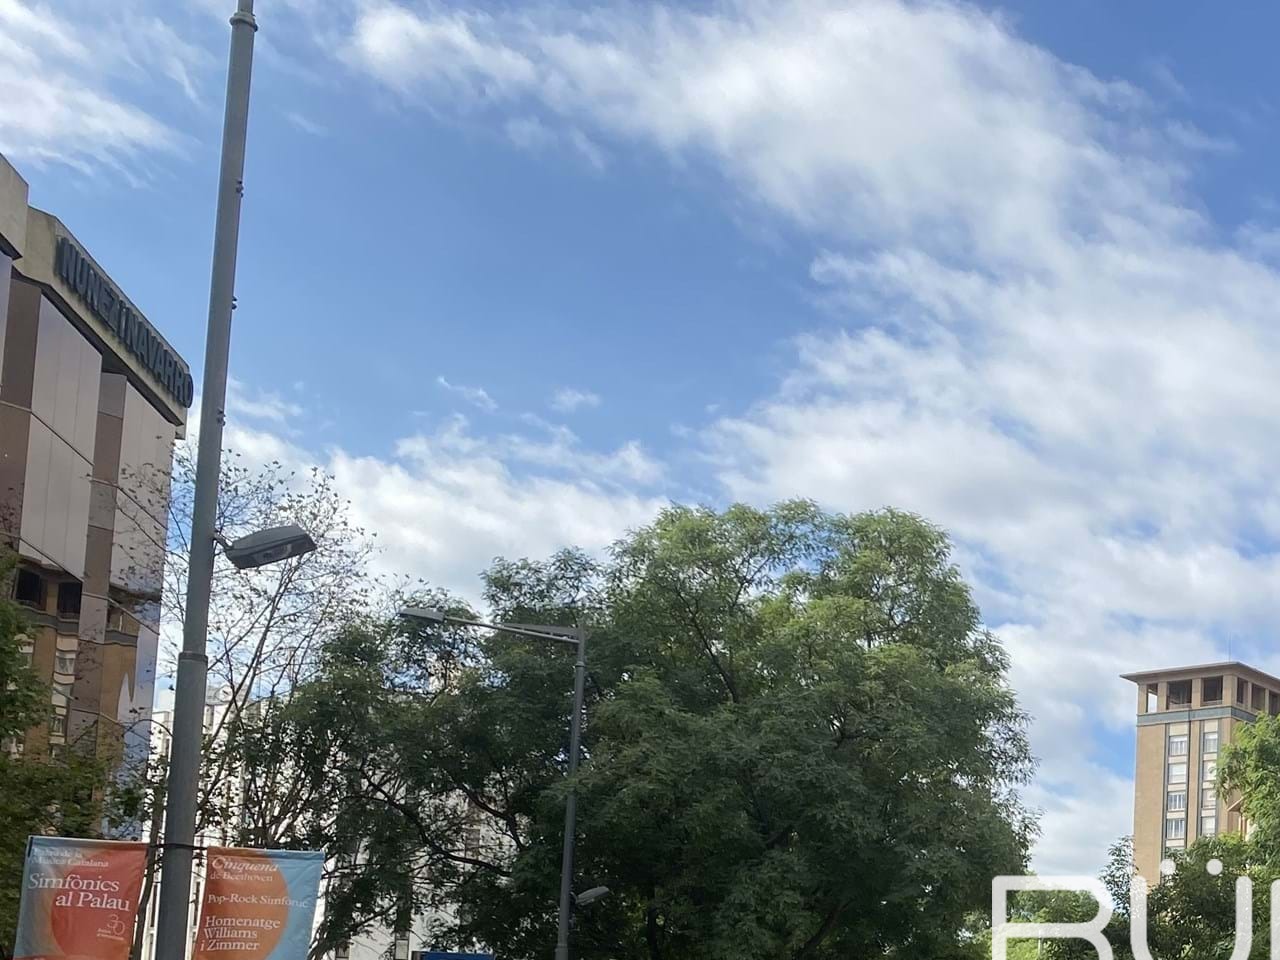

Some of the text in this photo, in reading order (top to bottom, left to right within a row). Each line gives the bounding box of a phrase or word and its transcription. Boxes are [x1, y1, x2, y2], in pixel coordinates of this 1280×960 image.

[211, 856, 279, 872] Cinquena
[28, 873, 120, 892] Simfònics
[222, 871, 274, 882] Beethoven
[55, 891, 130, 911] al Palau
[207, 893, 258, 906] Pop-Rock
[205, 915, 281, 930] Homenatge
[203, 926, 258, 939] Williams
[206, 940, 260, 952] Zimmer
